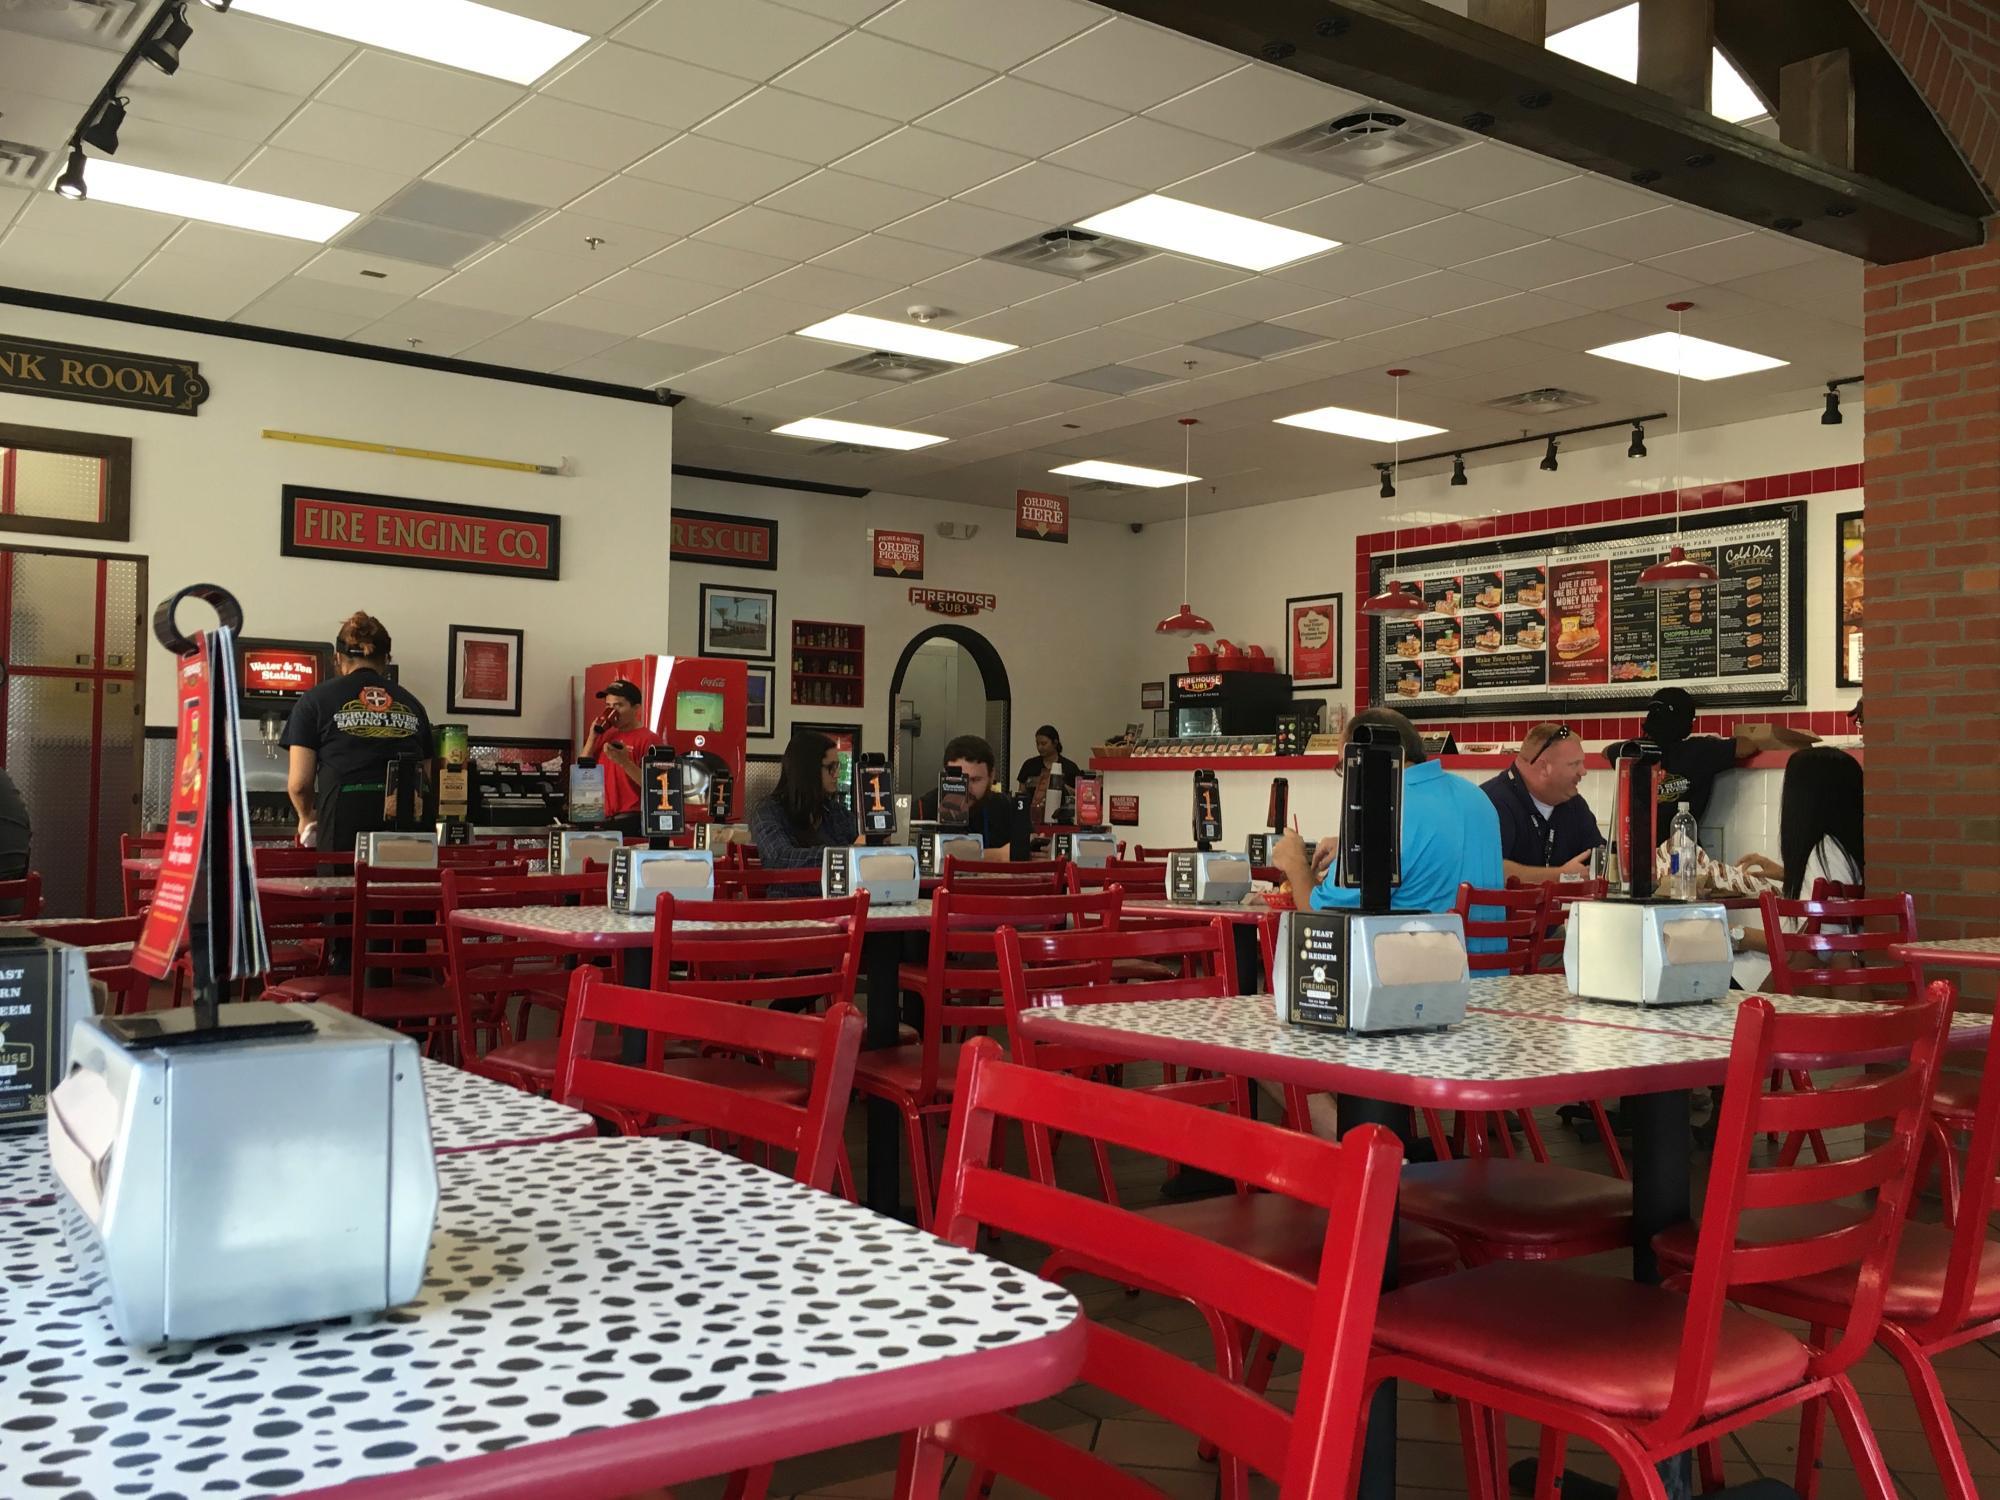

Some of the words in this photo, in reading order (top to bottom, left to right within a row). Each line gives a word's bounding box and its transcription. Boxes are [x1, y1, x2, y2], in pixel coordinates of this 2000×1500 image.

[0, 351, 47, 382] NK
[60, 359, 175, 398] ROOM
[1024, 497, 1061, 510] ORDER
[1022, 506, 1063, 523] HERE
[304, 507, 365, 543] FIRE
[377, 515, 488, 555] ENGINE
[498, 528, 541, 561] CO.
[671, 523, 763, 555] RESCUE
[878, 542, 919, 554] ORDER
[1726, 546, 1750, 563] Cold
[1753, 545, 1773, 559] Deli
[879, 551, 919, 561] PICK-UPS
[1559, 580, 1573, 589] LOVE
[1581, 578, 1597, 586] AFTER
[1588, 585, 1603, 593] YOUR
[911, 590, 994, 609] FIREHOUSE
[1556, 596, 1579, 606] MONEY
[938, 602, 968, 613] SUBS
[249, 662, 282, 671] Water
[283, 661, 293, 671] &
[294, 662, 312, 674] Tea
[262, 671, 301, 681] Station
[1178, 675, 1221, 688] FIREHOUSE
[333, 711, 387, 721] SERVING
[337, 719, 381, 729] SAVING
[656, 771, 673, 810] 1
[716, 783, 726, 805] 1
[869, 775, 885, 811] 1
[896, 798, 908, 808] 45
[1017, 801, 1024, 810] 3
[1202, 790, 1214, 820] 1
[1312, 929, 1334, 938] FEAST
[1313, 941, 1332, 950] EARN
[1308, 952, 1337, 962] REDEEM
[1302, 981, 1336, 993] FIREHOUSE
